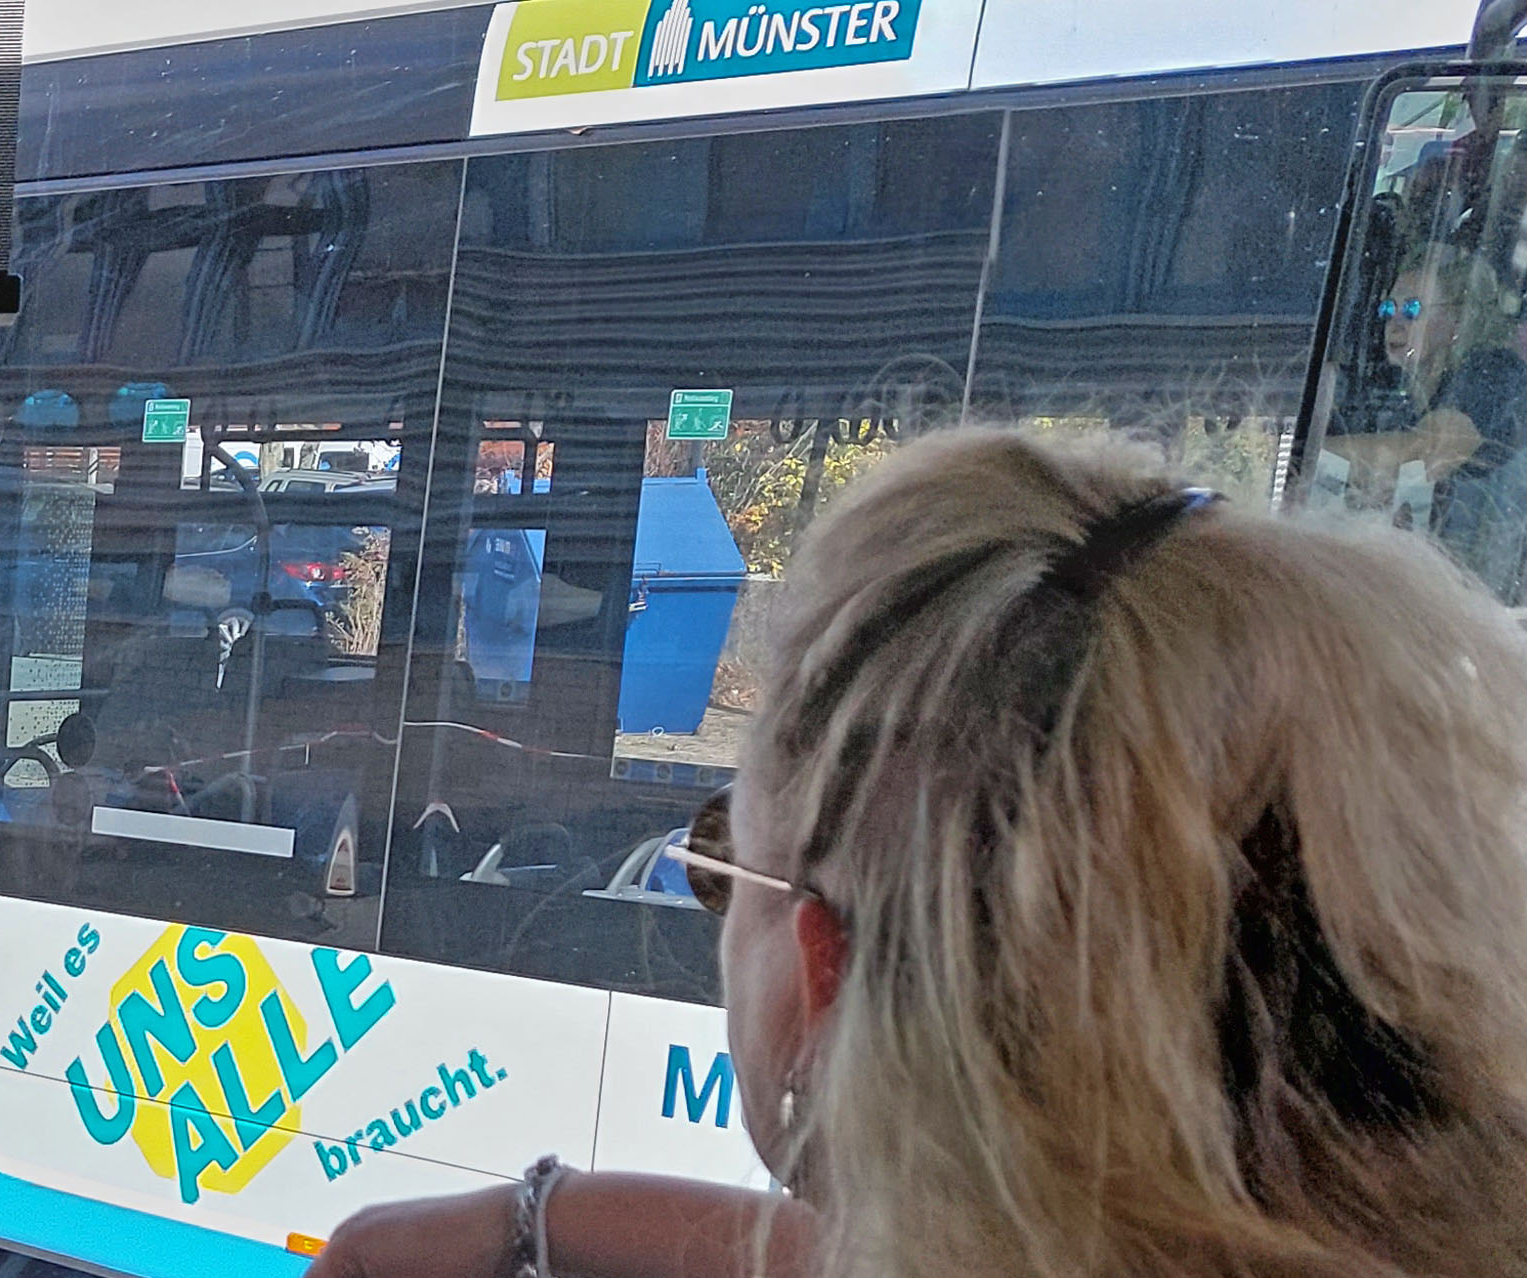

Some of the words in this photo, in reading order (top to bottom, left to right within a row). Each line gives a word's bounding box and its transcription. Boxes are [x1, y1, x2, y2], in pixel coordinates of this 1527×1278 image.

[513, 31, 634, 81] STADT
[697, 0, 899, 62] MÜNSTER
[0, 970, 68, 1070] Weil
[64, 922, 100, 978] es
[65, 927, 246, 1145] UNS
[170, 947, 396, 1204] ALLE
[313, 1048, 508, 1182] braucht.
